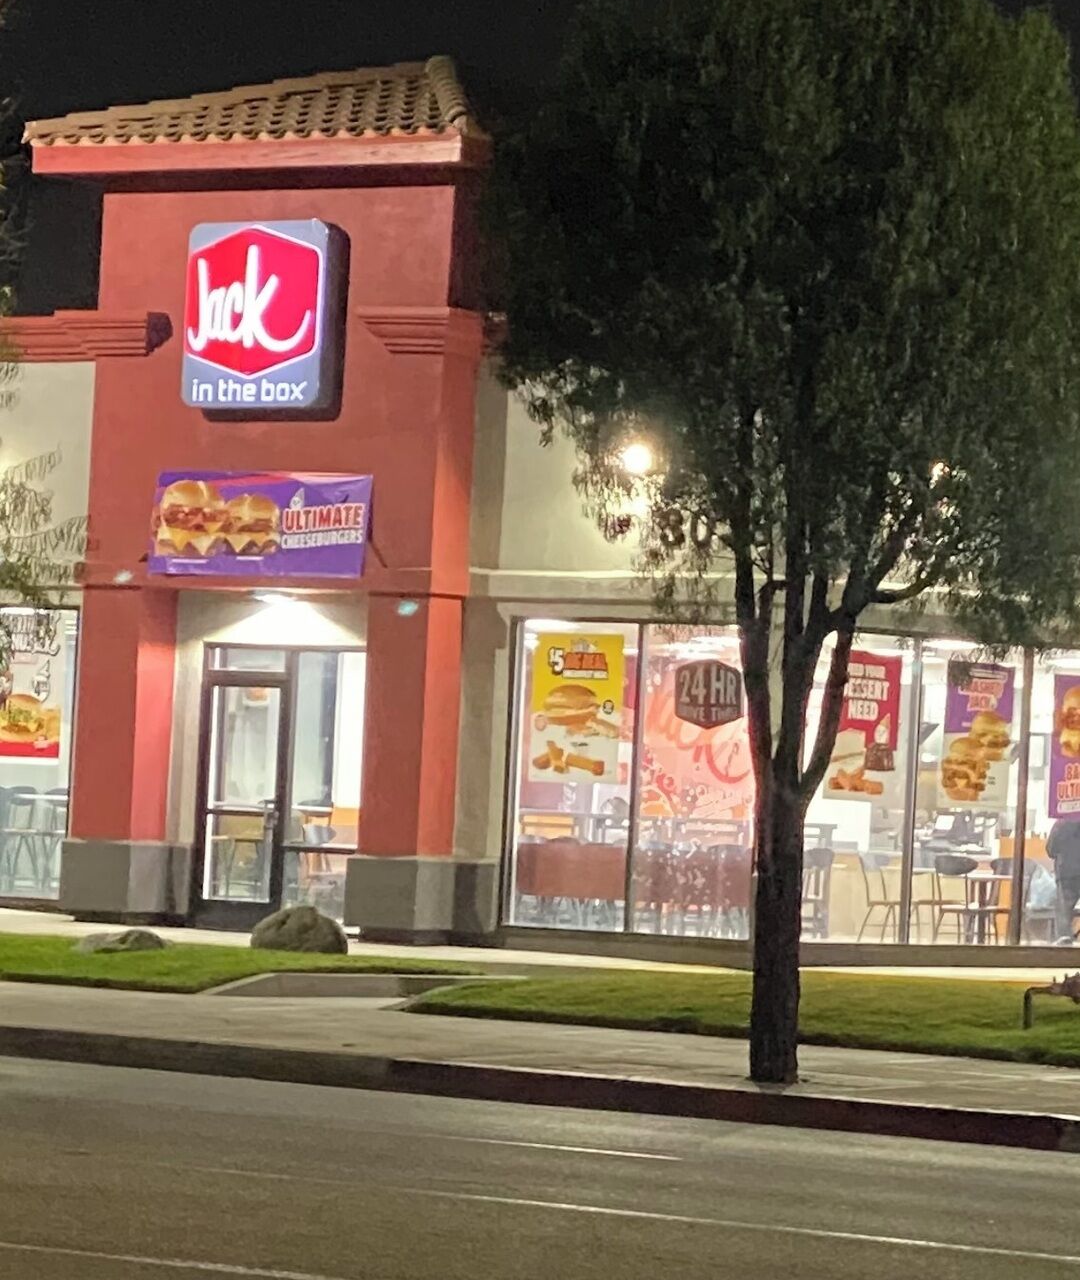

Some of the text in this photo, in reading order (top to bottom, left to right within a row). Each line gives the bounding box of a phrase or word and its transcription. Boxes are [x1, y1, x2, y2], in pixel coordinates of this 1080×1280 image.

[187, 244, 311, 352] Jack
[191, 379, 308, 403] in the box
[283, 503, 366, 533] ULTIMATE
[281, 530, 364, 550] CHEESEBURGERS
[680, 664, 737, 704] 24 HR
